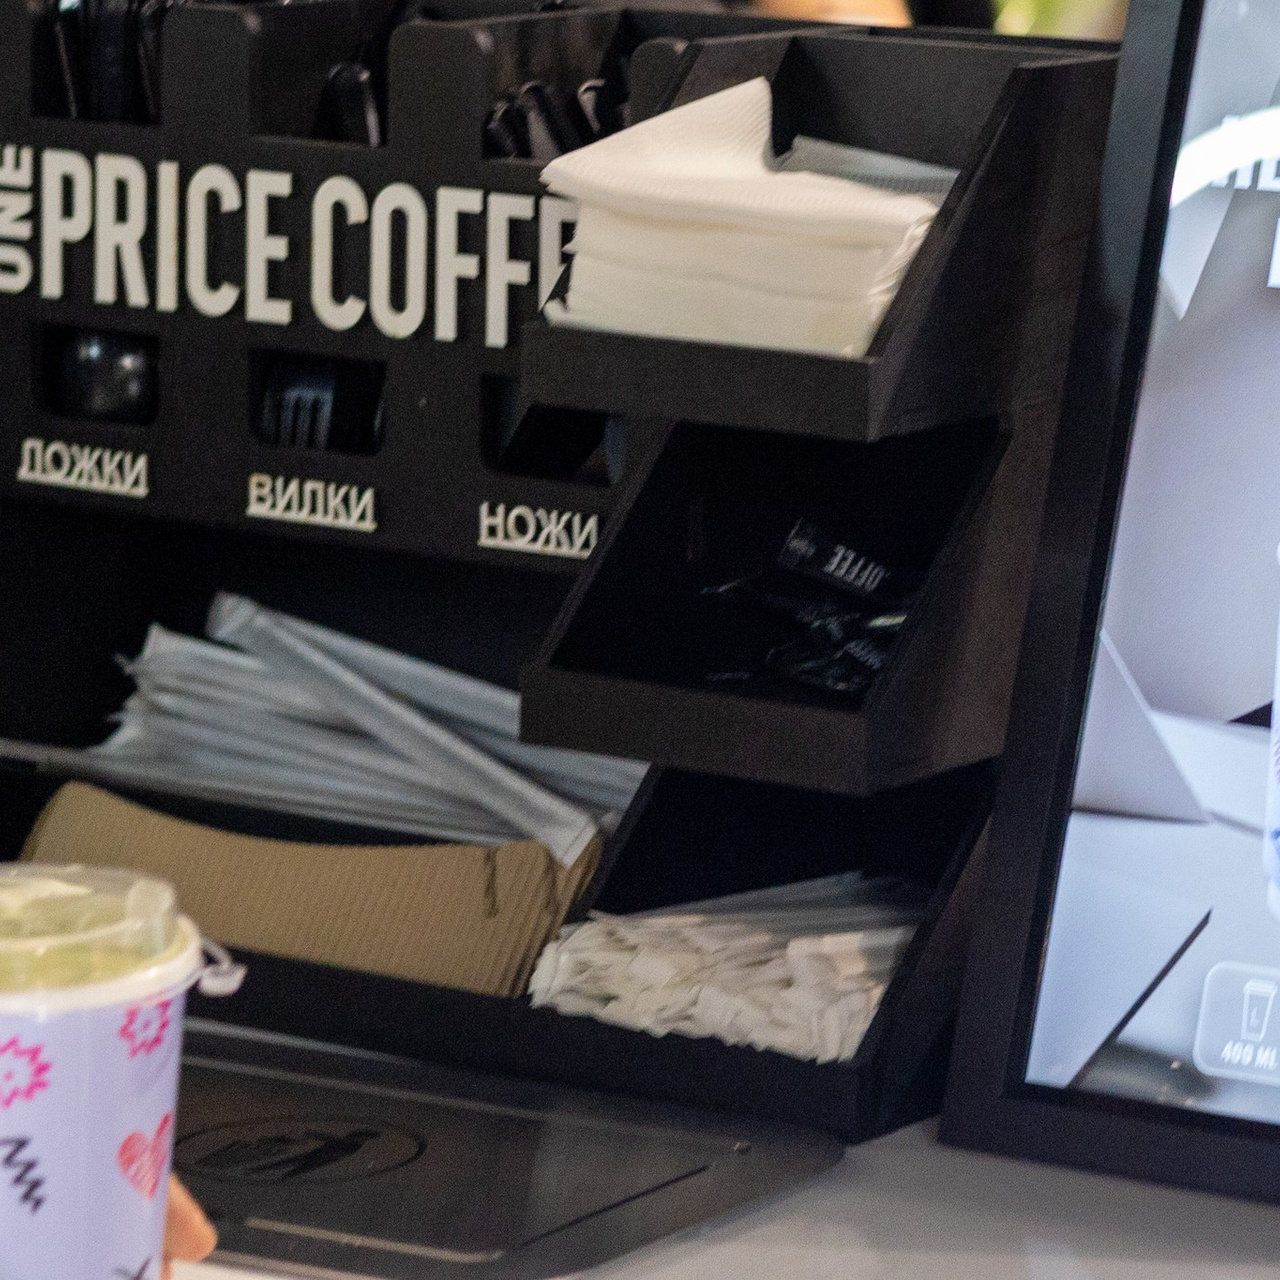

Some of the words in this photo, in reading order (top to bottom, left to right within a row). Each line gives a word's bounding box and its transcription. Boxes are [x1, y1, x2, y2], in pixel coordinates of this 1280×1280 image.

[40, 149, 293, 325] PRICE
[17, 437, 150, 497] ЛОЖКИ
[247, 472, 378, 532] ВИЛКИ
[478, 501, 600, 559] НОЖИ
[1221, 1040, 1255, 1066] 400
